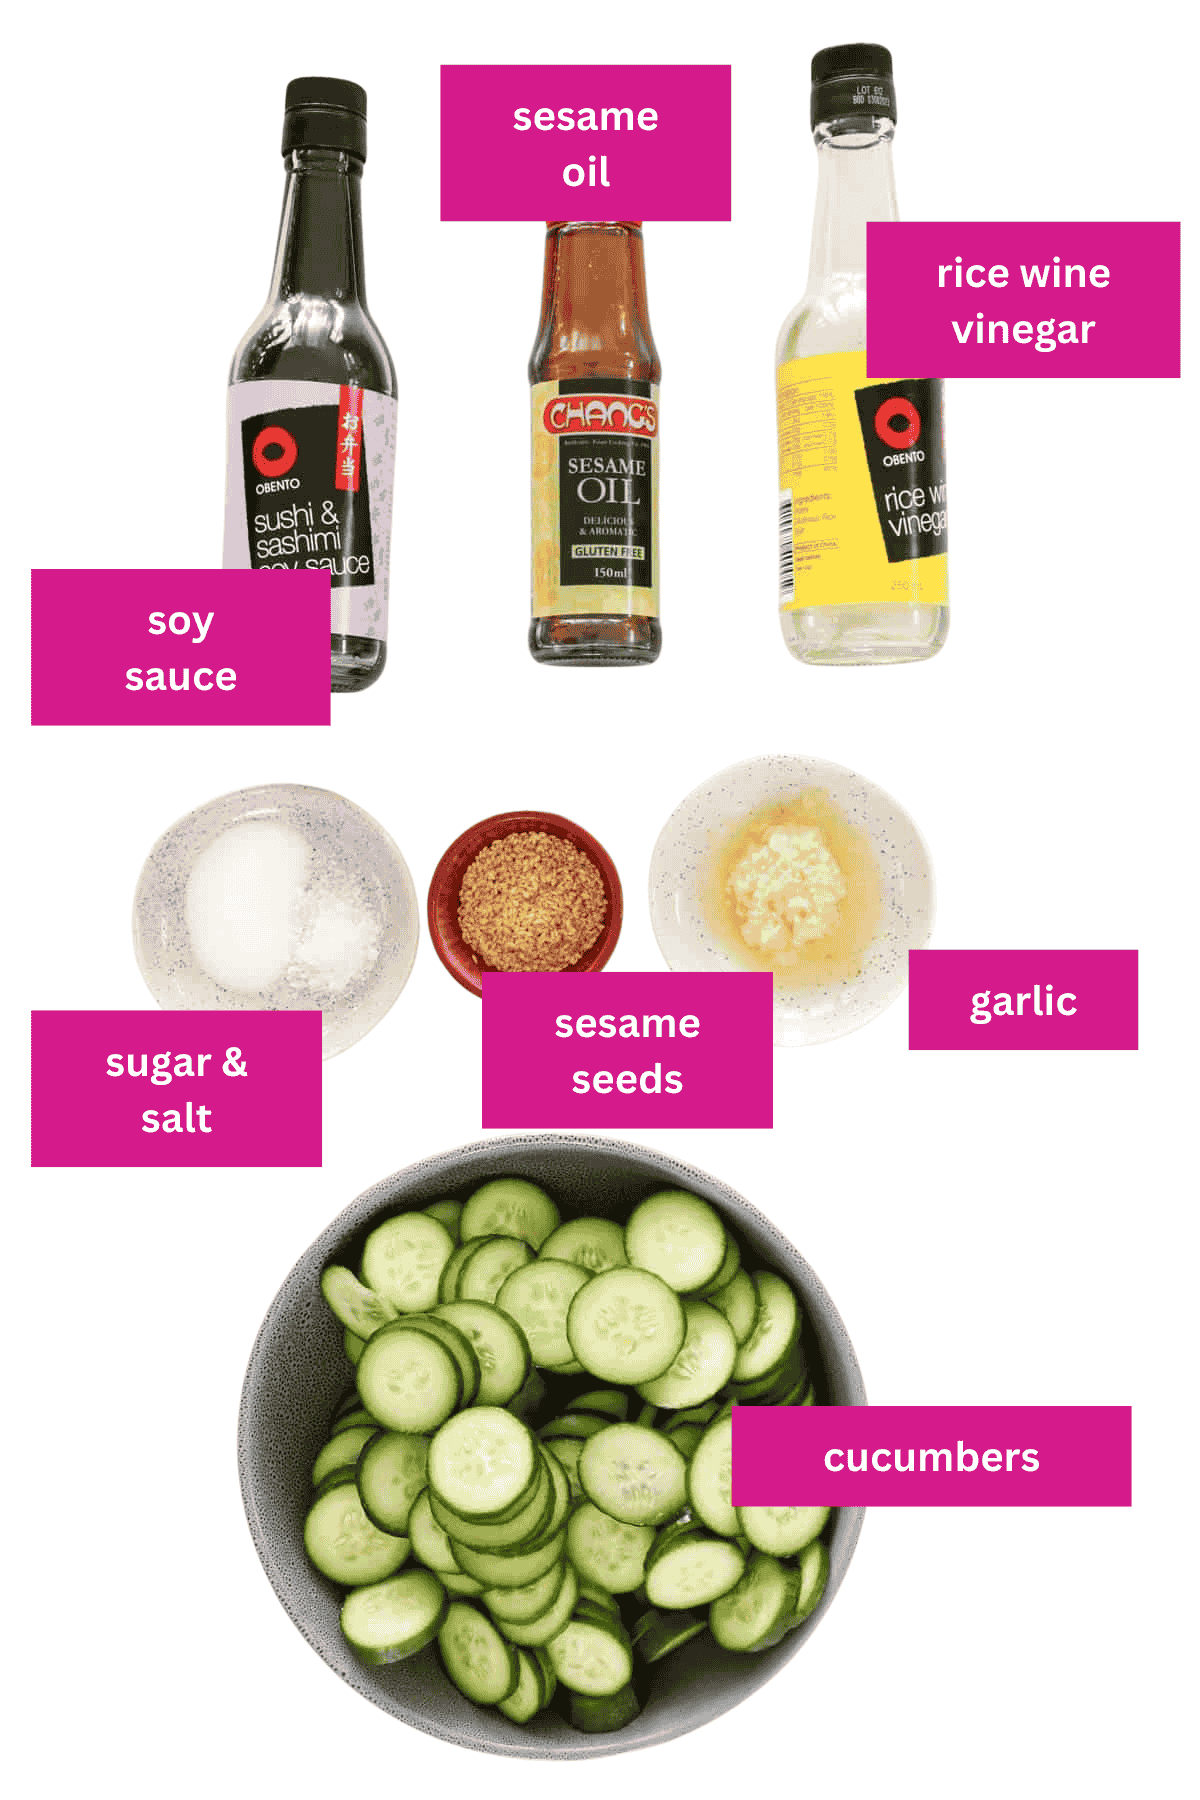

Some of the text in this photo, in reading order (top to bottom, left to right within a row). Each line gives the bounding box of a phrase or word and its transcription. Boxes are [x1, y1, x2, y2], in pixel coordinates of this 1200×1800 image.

[550, 400, 656, 433] CHANG'S
[340, 411, 360, 476] お弁当
[568, 457, 647, 477] SESAME
[883, 450, 926, 468] OBENTO
[255, 477, 301, 496] OBENTO
[577, 476, 641, 505] OIL
[884, 485, 926, 513] rice
[254, 500, 341, 534] sushi &
[256, 525, 342, 559] sashimi
[589, 527, 639, 537] AROMATIC
[575, 546, 644, 559] GLUTEN FREE
[594, 567, 627, 578] 150ml
